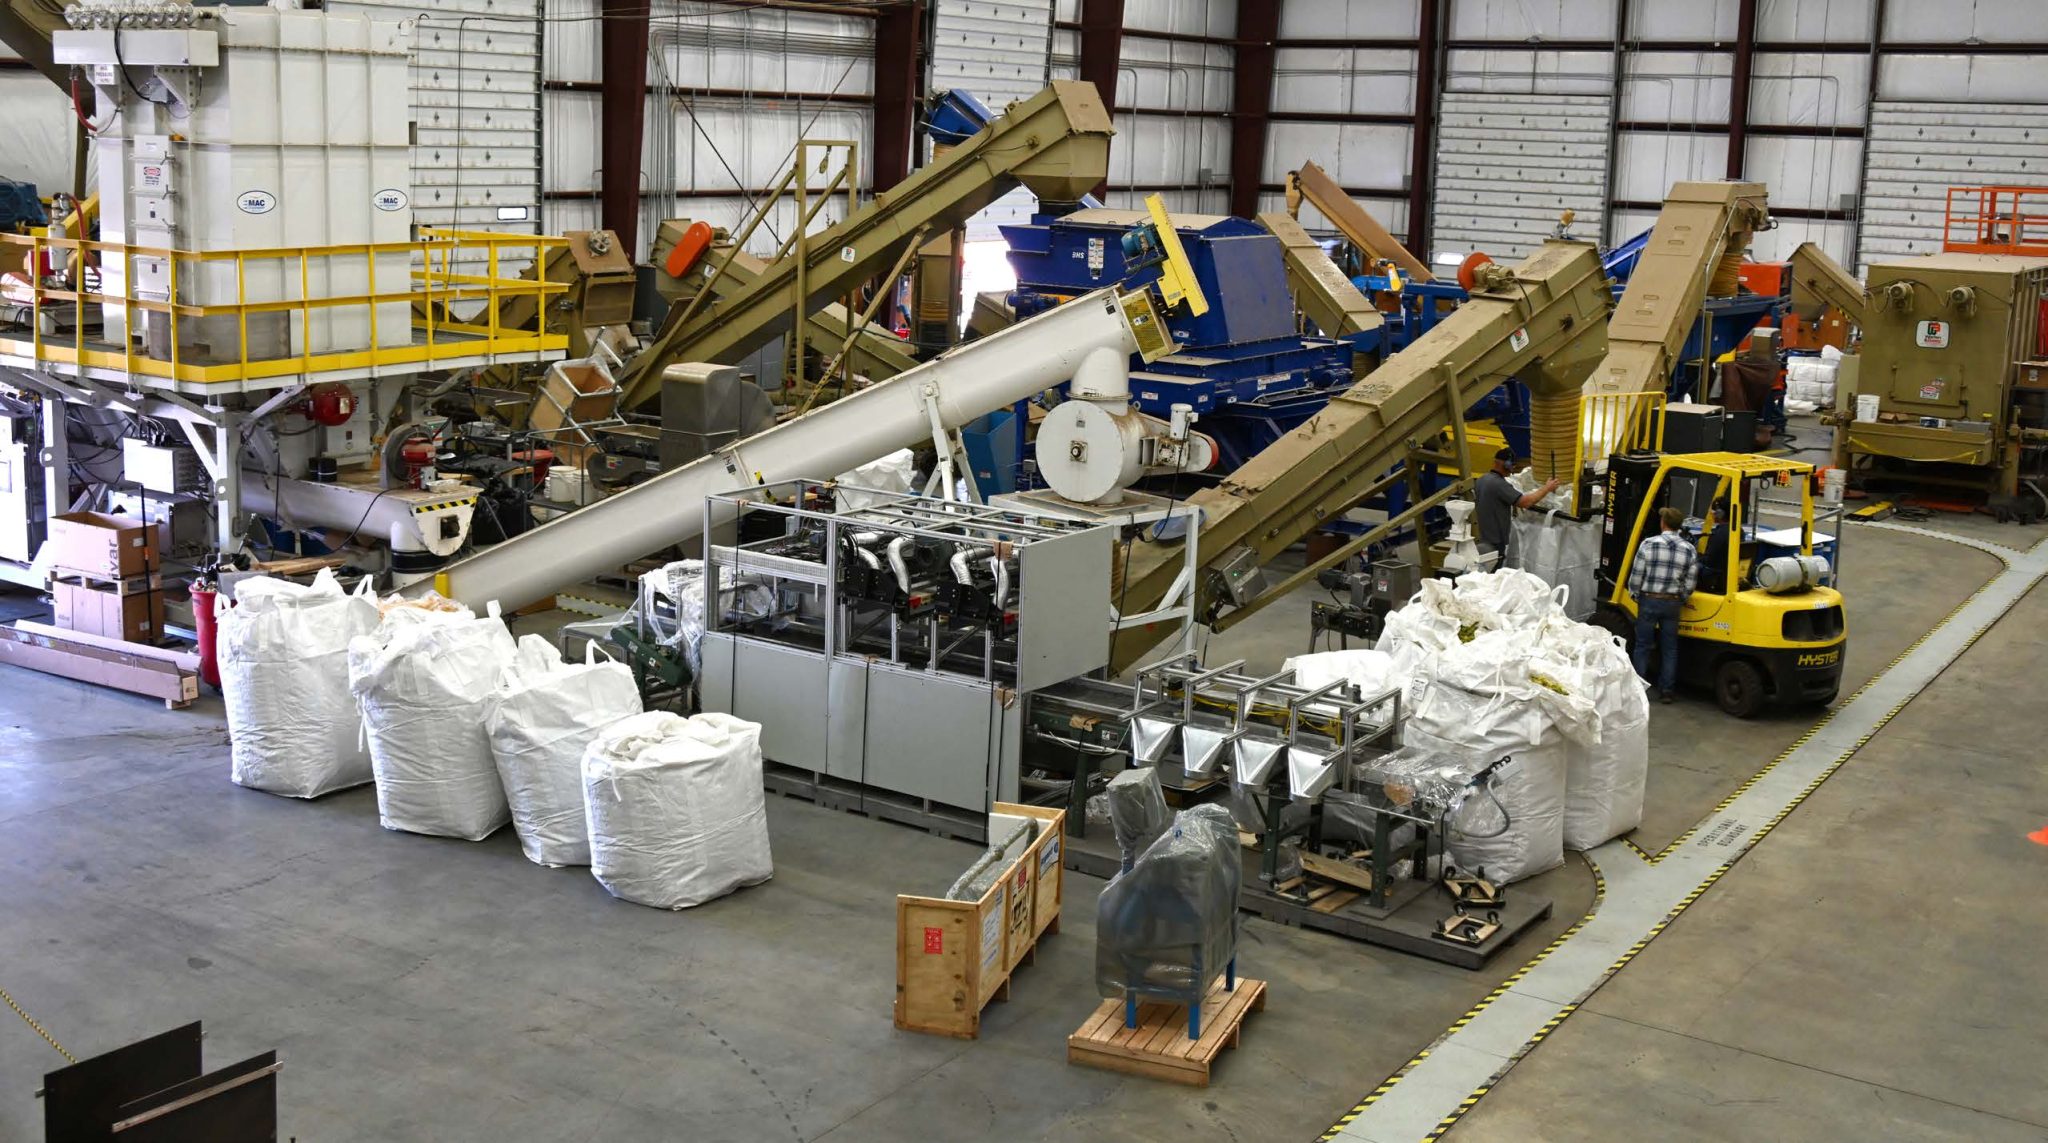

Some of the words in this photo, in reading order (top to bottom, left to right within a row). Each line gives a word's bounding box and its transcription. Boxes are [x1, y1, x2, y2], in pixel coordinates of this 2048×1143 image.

[1607, 470, 1617, 516] HYSTER
[1797, 650, 1839, 666] HYSTER
[1696, 818, 1738, 847] OPERATIONAL
[1716, 824, 1750, 847] BOUNDARY
